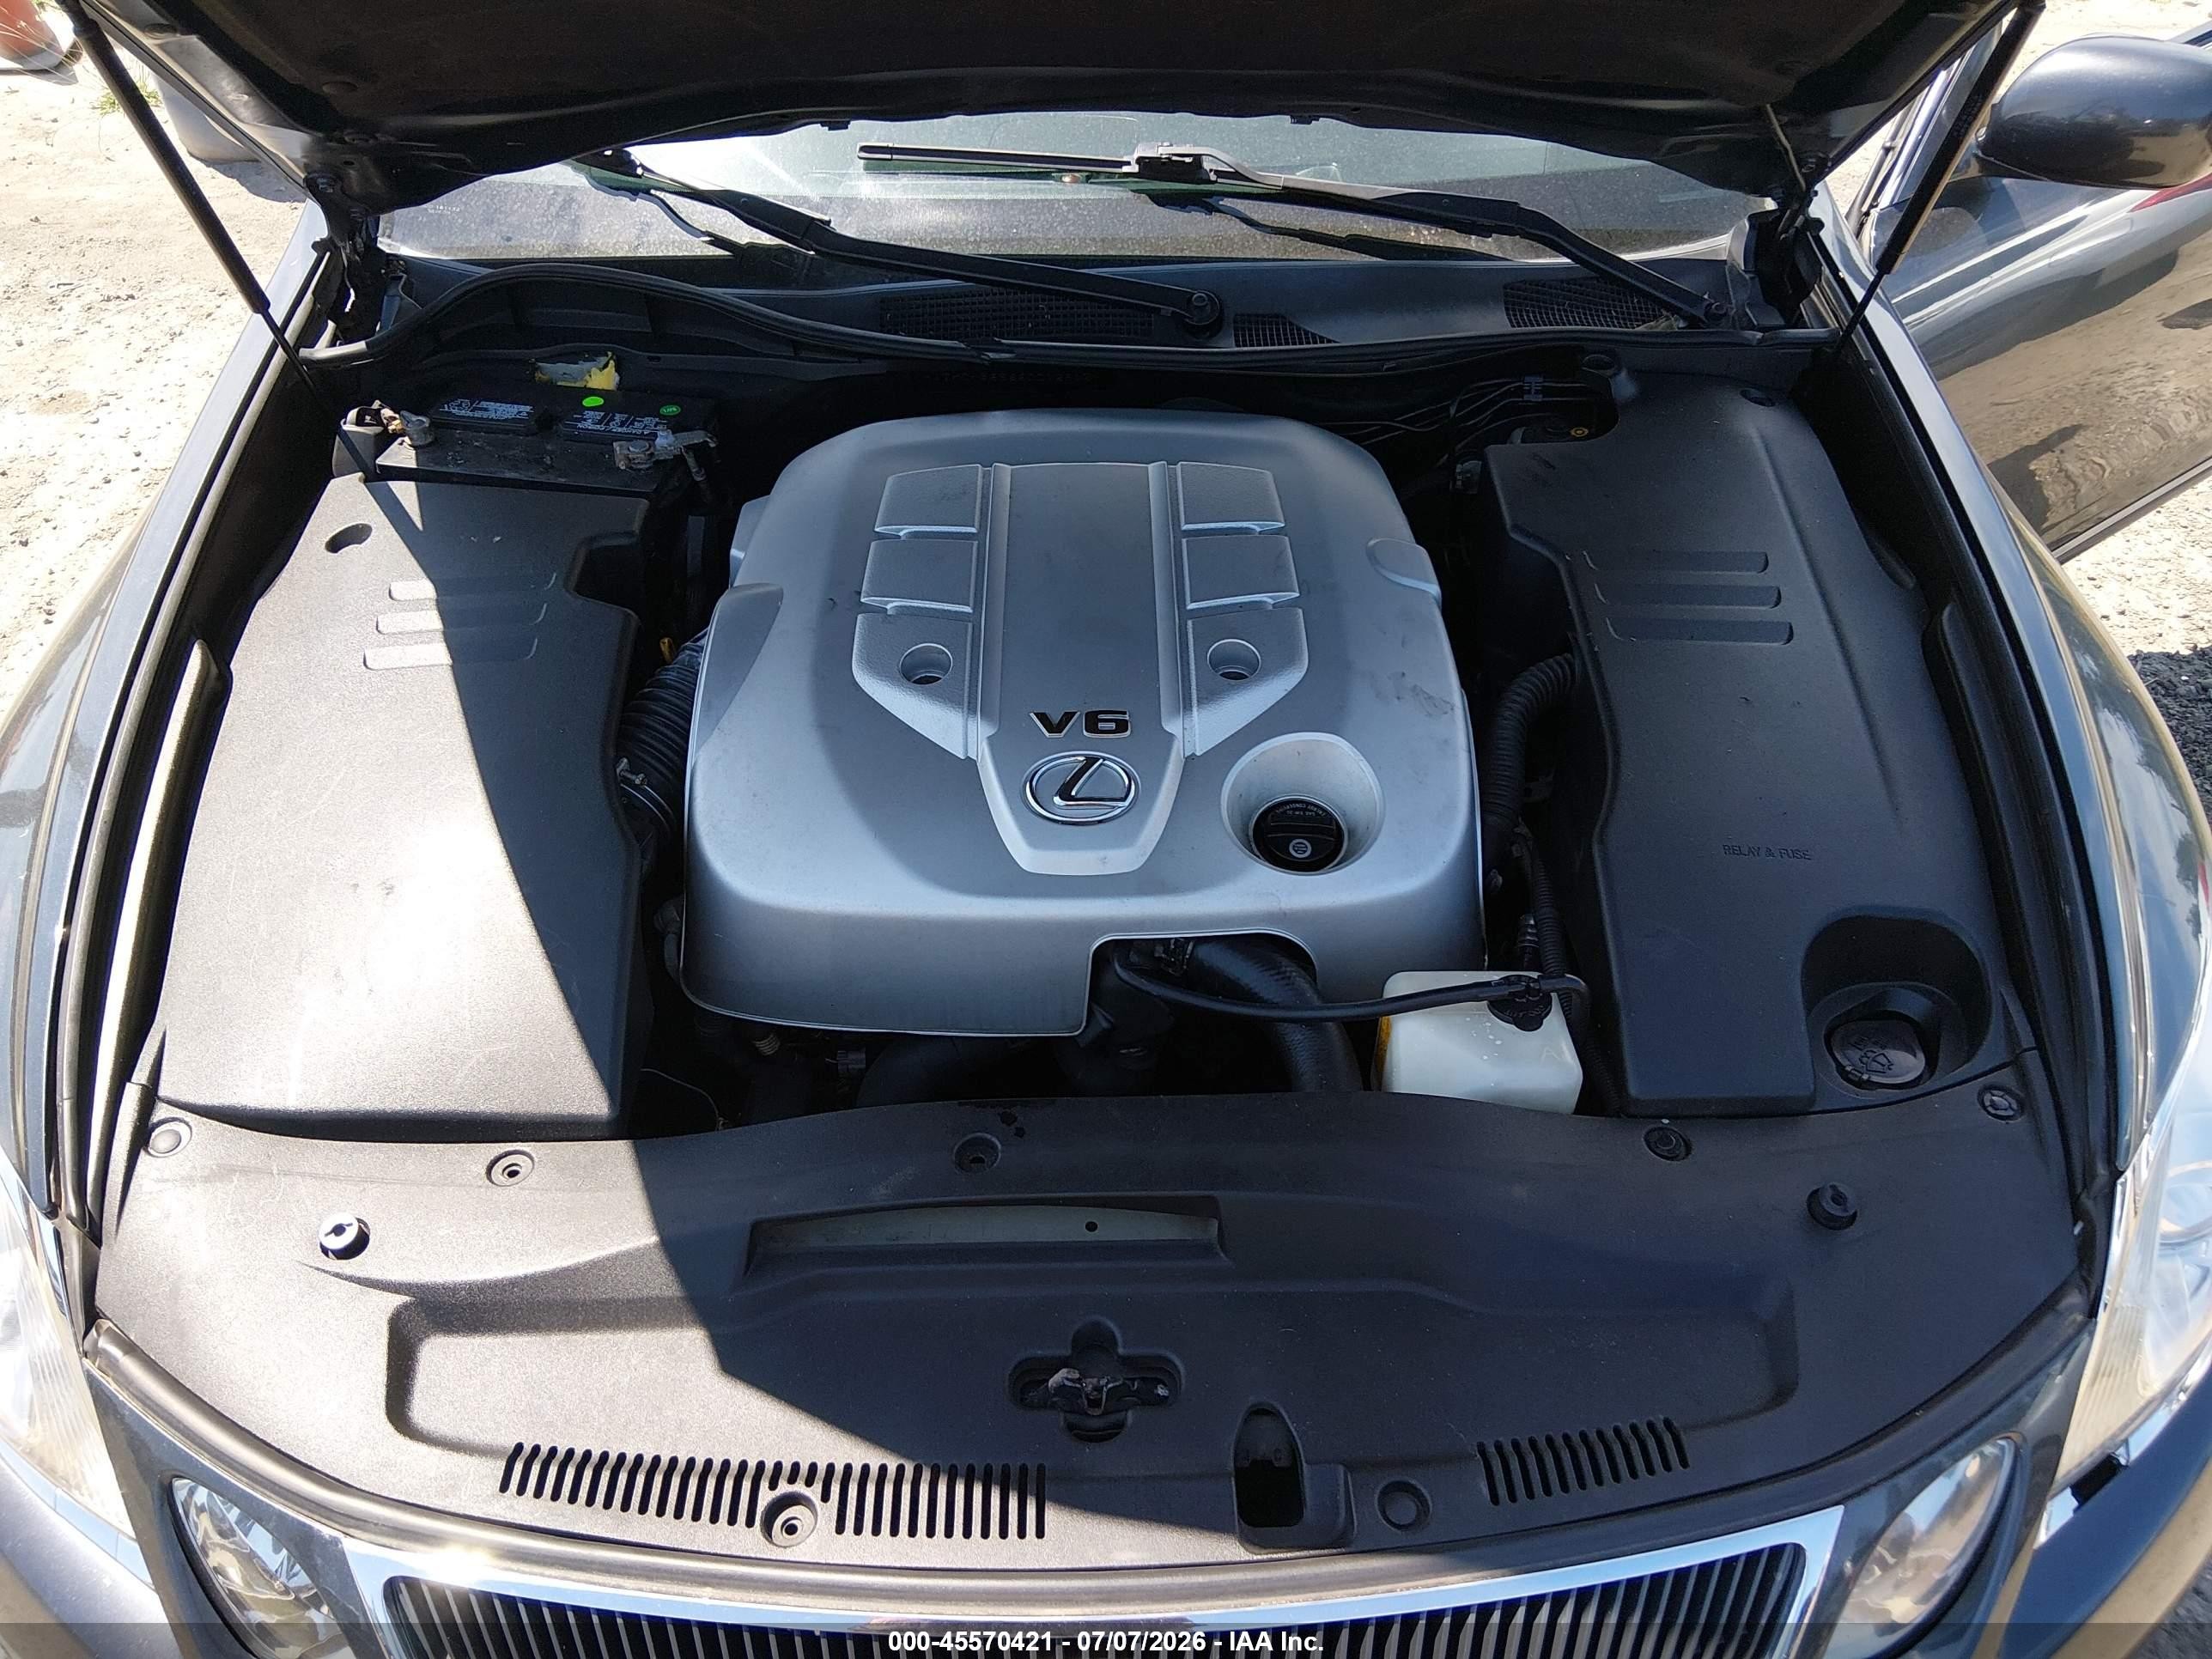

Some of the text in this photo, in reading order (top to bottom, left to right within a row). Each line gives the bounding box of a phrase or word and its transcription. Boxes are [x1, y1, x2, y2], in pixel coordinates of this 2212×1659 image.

[1029, 709, 1131, 738] V6
[1723, 844, 1812, 860] RELAY & FUSE
